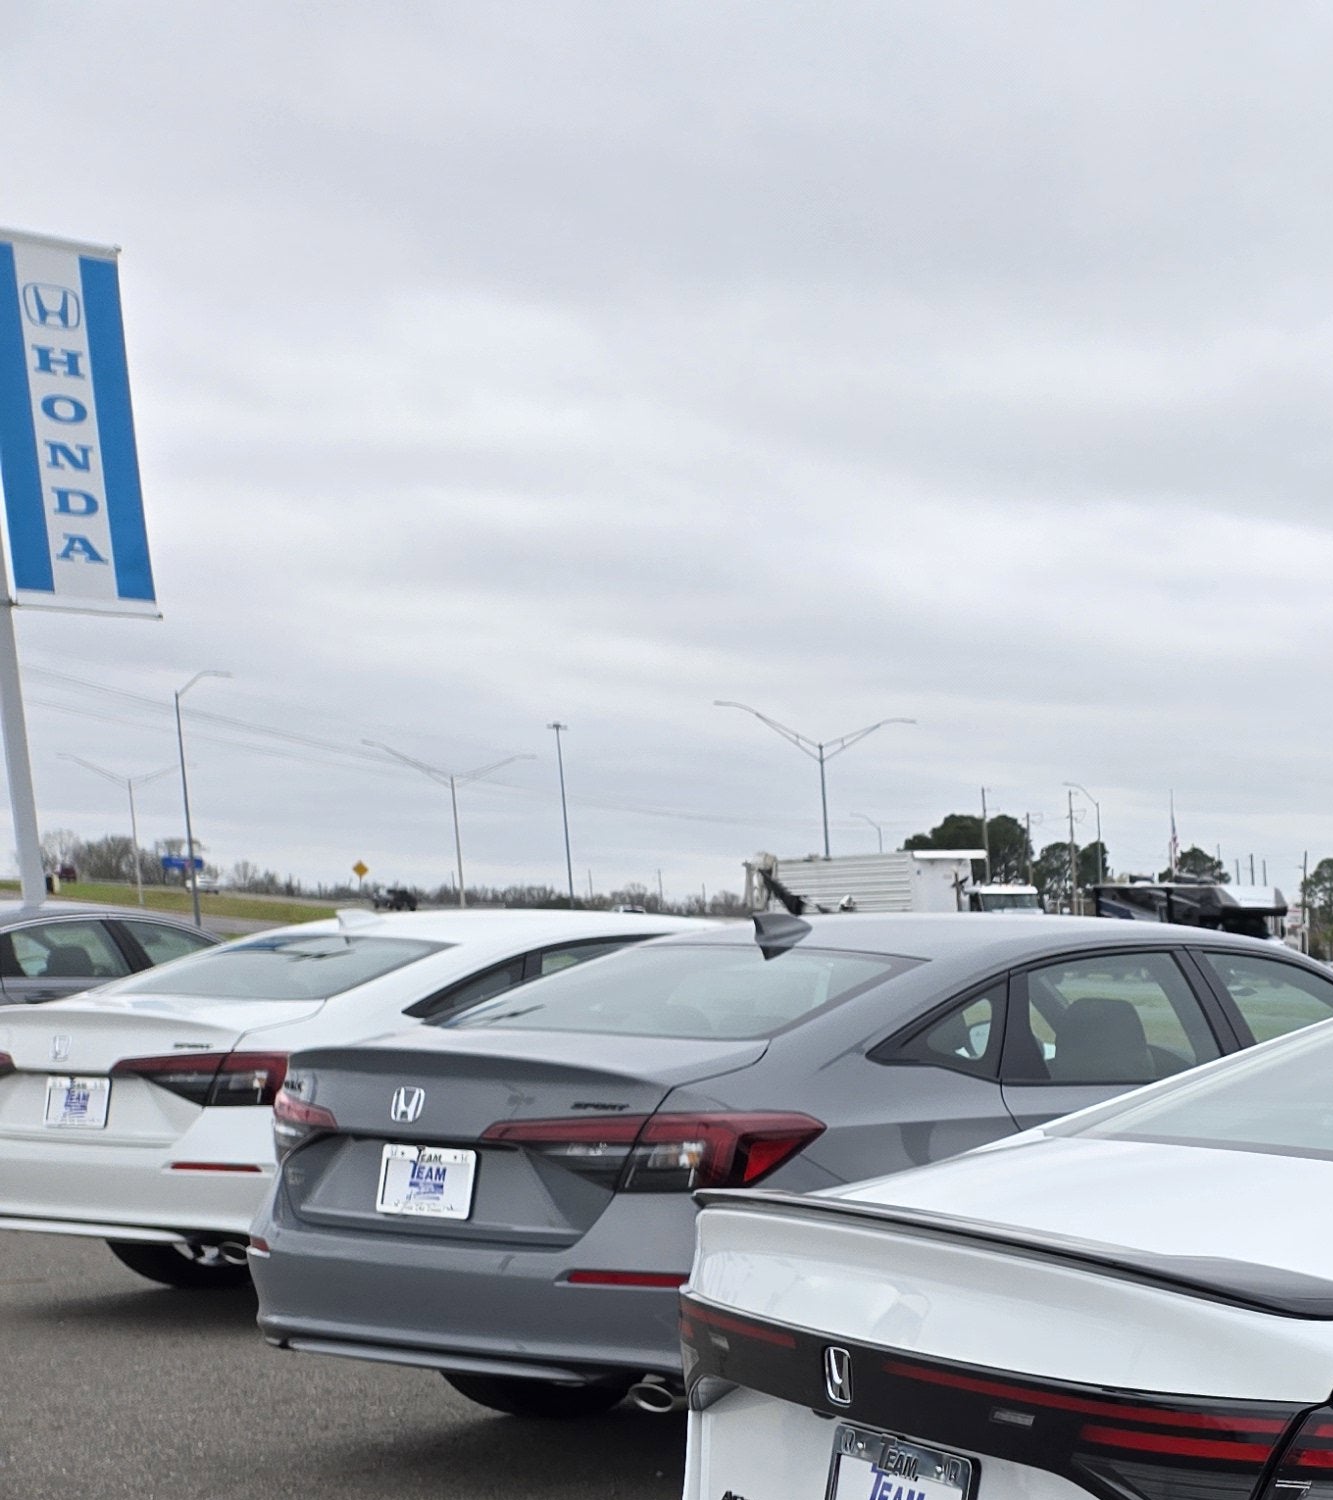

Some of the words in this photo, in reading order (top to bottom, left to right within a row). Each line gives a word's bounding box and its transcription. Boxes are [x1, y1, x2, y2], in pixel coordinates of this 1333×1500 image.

[31, 343, 109, 566] HONDA
[409, 1160, 447, 1183] TEAM
[416, 1145, 443, 1165] TEAM
[877, 1433, 920, 1482] TEAM
